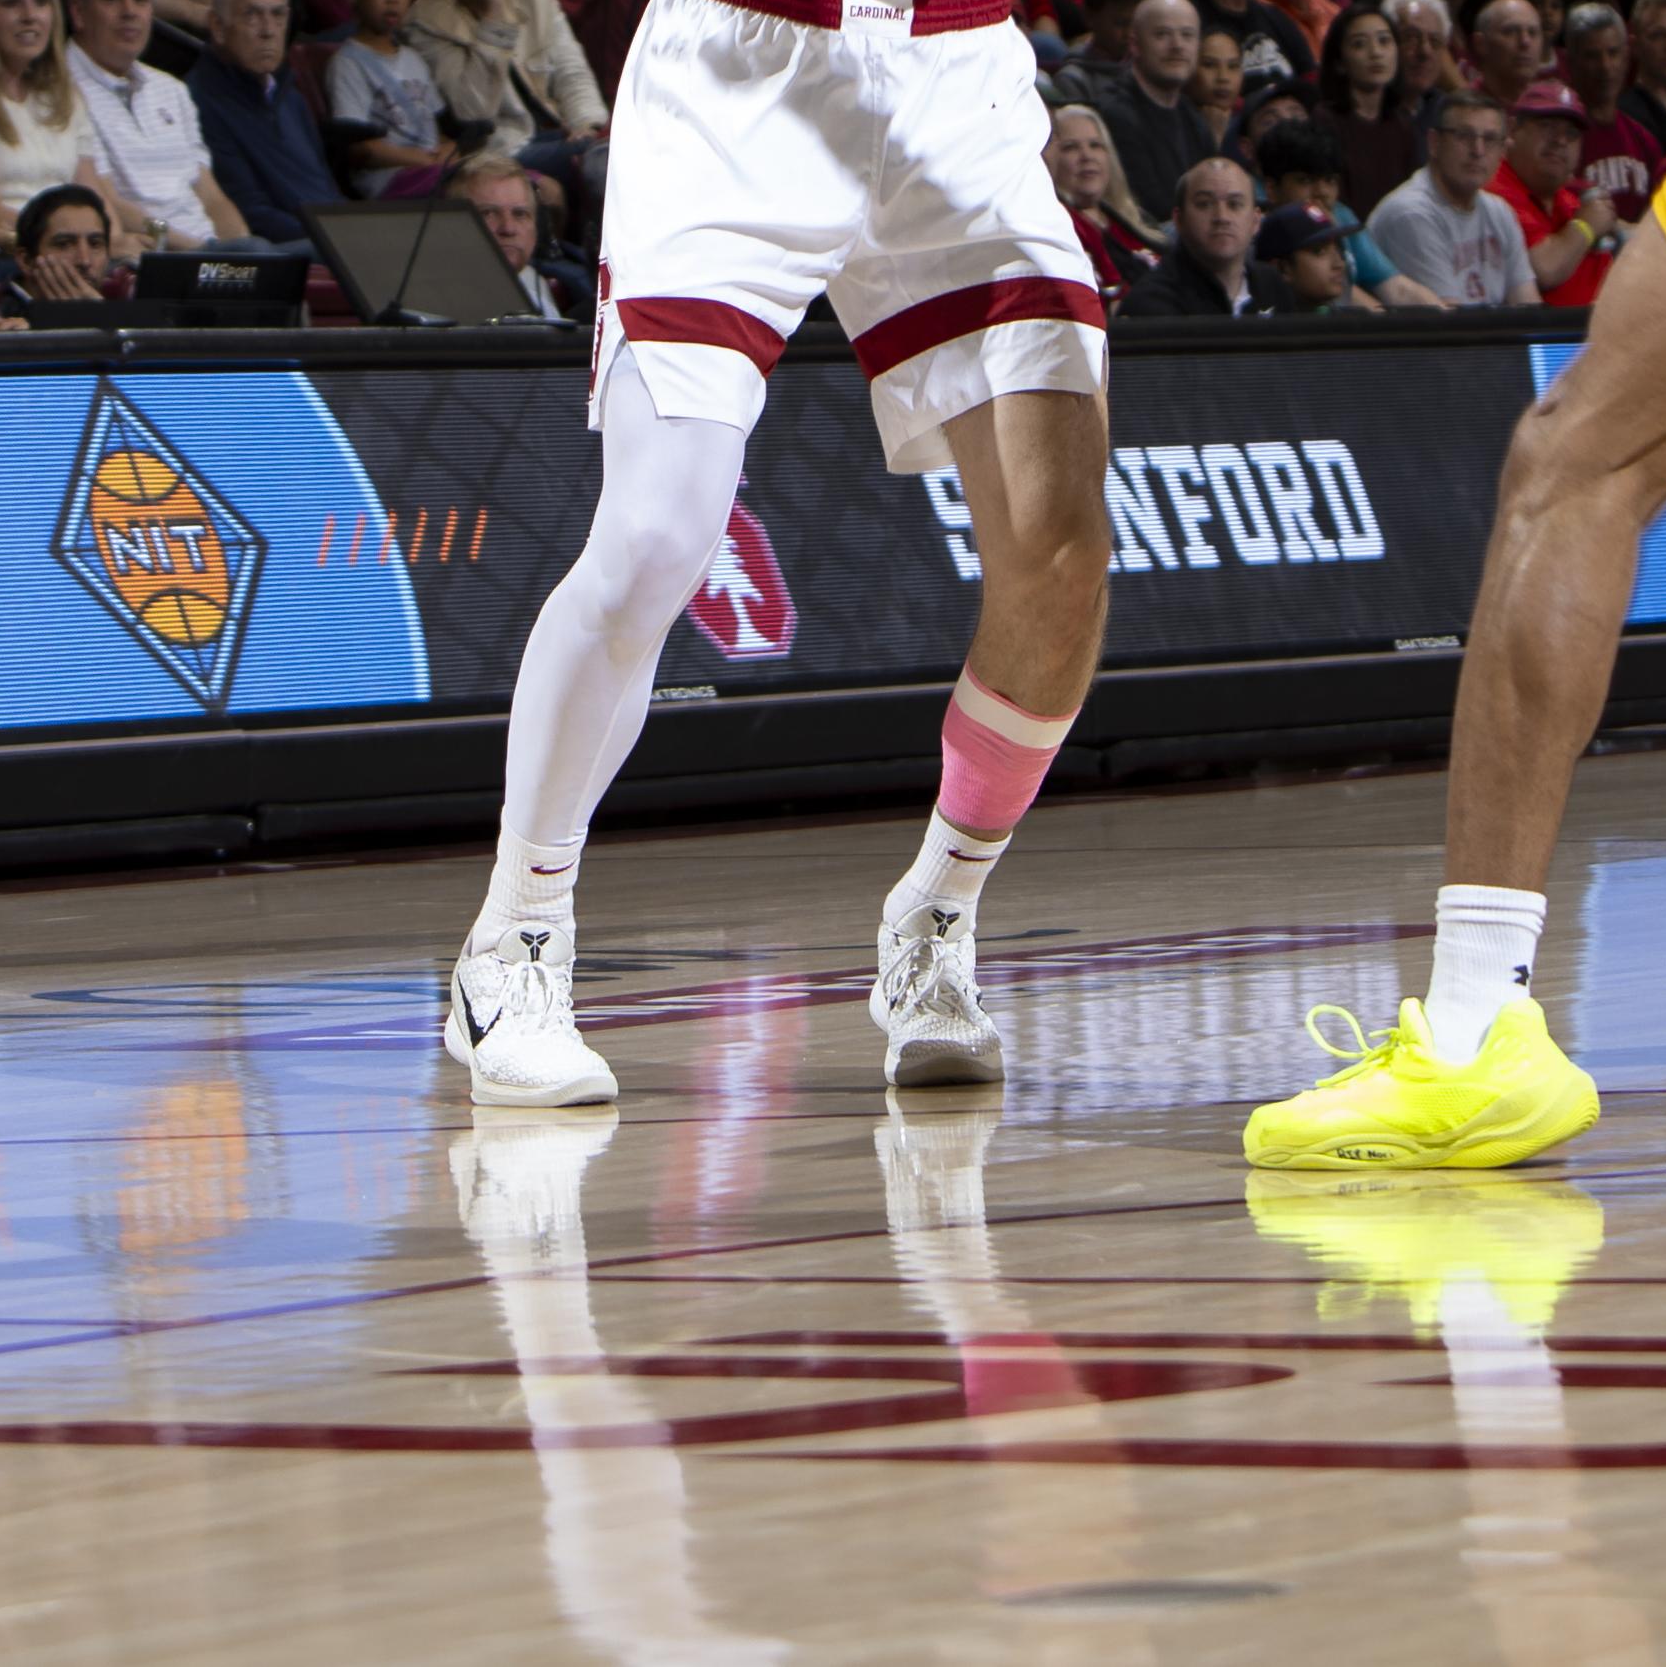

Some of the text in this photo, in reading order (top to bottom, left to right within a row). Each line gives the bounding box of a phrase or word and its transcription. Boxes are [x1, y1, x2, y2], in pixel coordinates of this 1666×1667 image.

[849, 4, 907, 22] CARDINAL
[921, 439, 1386, 581] SNFORD
[105, 524, 208, 575] NIT
